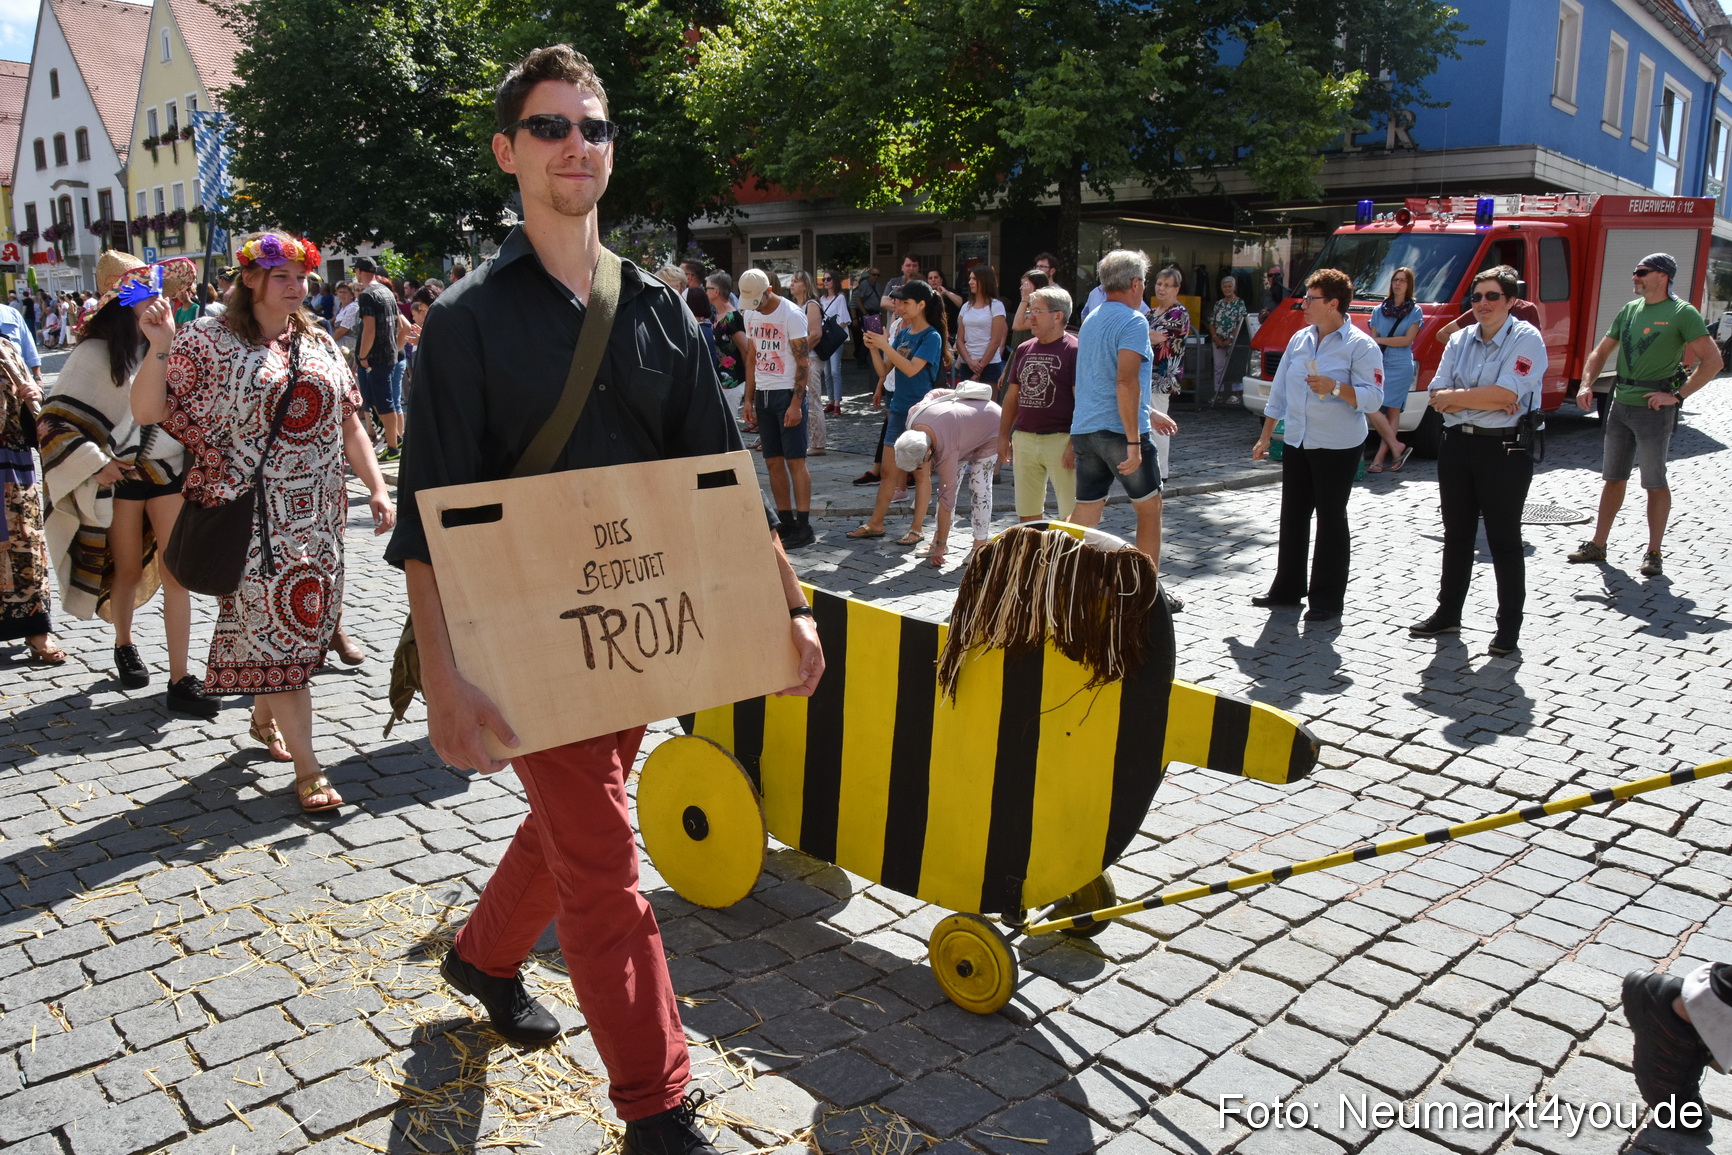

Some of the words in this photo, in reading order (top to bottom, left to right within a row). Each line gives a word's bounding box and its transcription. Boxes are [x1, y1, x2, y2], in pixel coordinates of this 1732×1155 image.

[1629, 199, 1676, 213] FEUERWEHR
[1683, 201, 1695, 213] 112
[146, 249, 154, 263] P
[594, 518, 633, 550] DIES
[577, 551, 665, 595] BEDEUTET
[560, 591, 705, 674] TROJA
